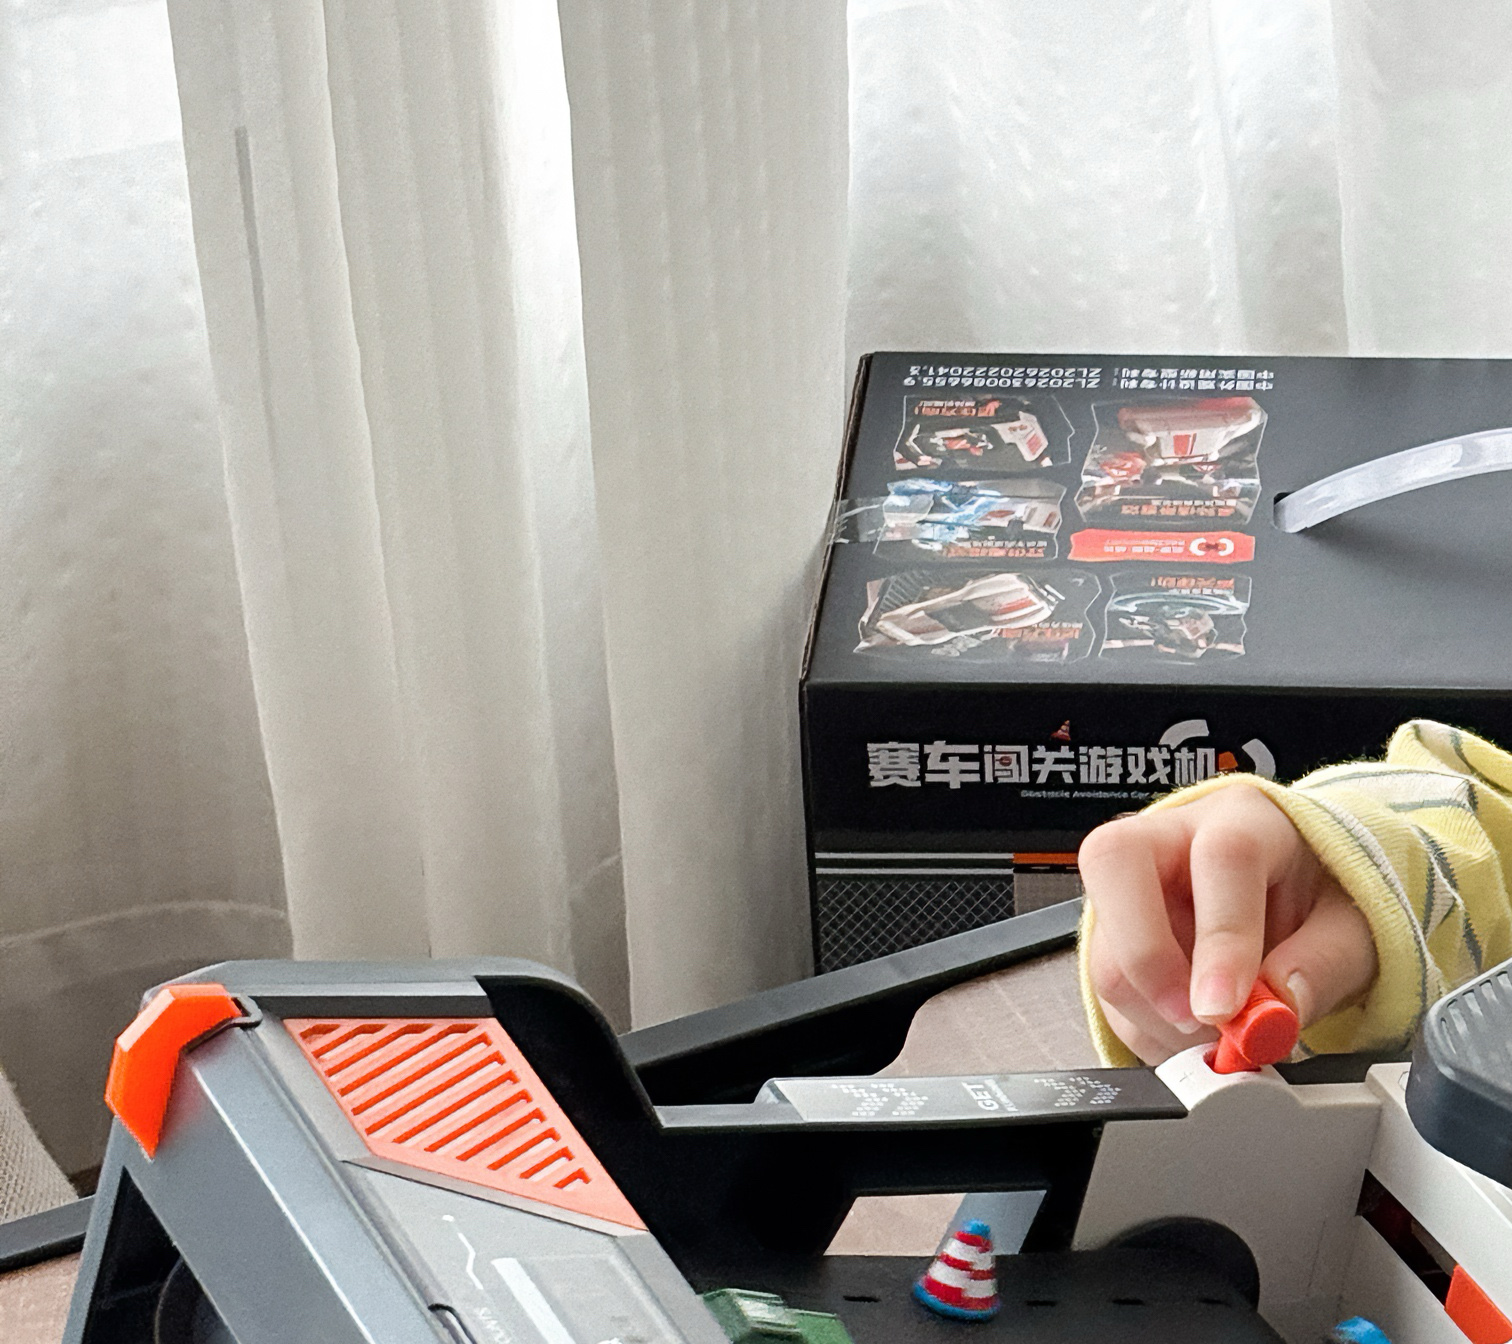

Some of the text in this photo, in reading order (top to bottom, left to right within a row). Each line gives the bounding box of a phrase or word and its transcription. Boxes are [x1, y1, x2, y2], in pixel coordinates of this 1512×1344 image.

[866, 740, 1216, 789] 赛车闯关游戏机
[961, 1081, 999, 1112] GET
